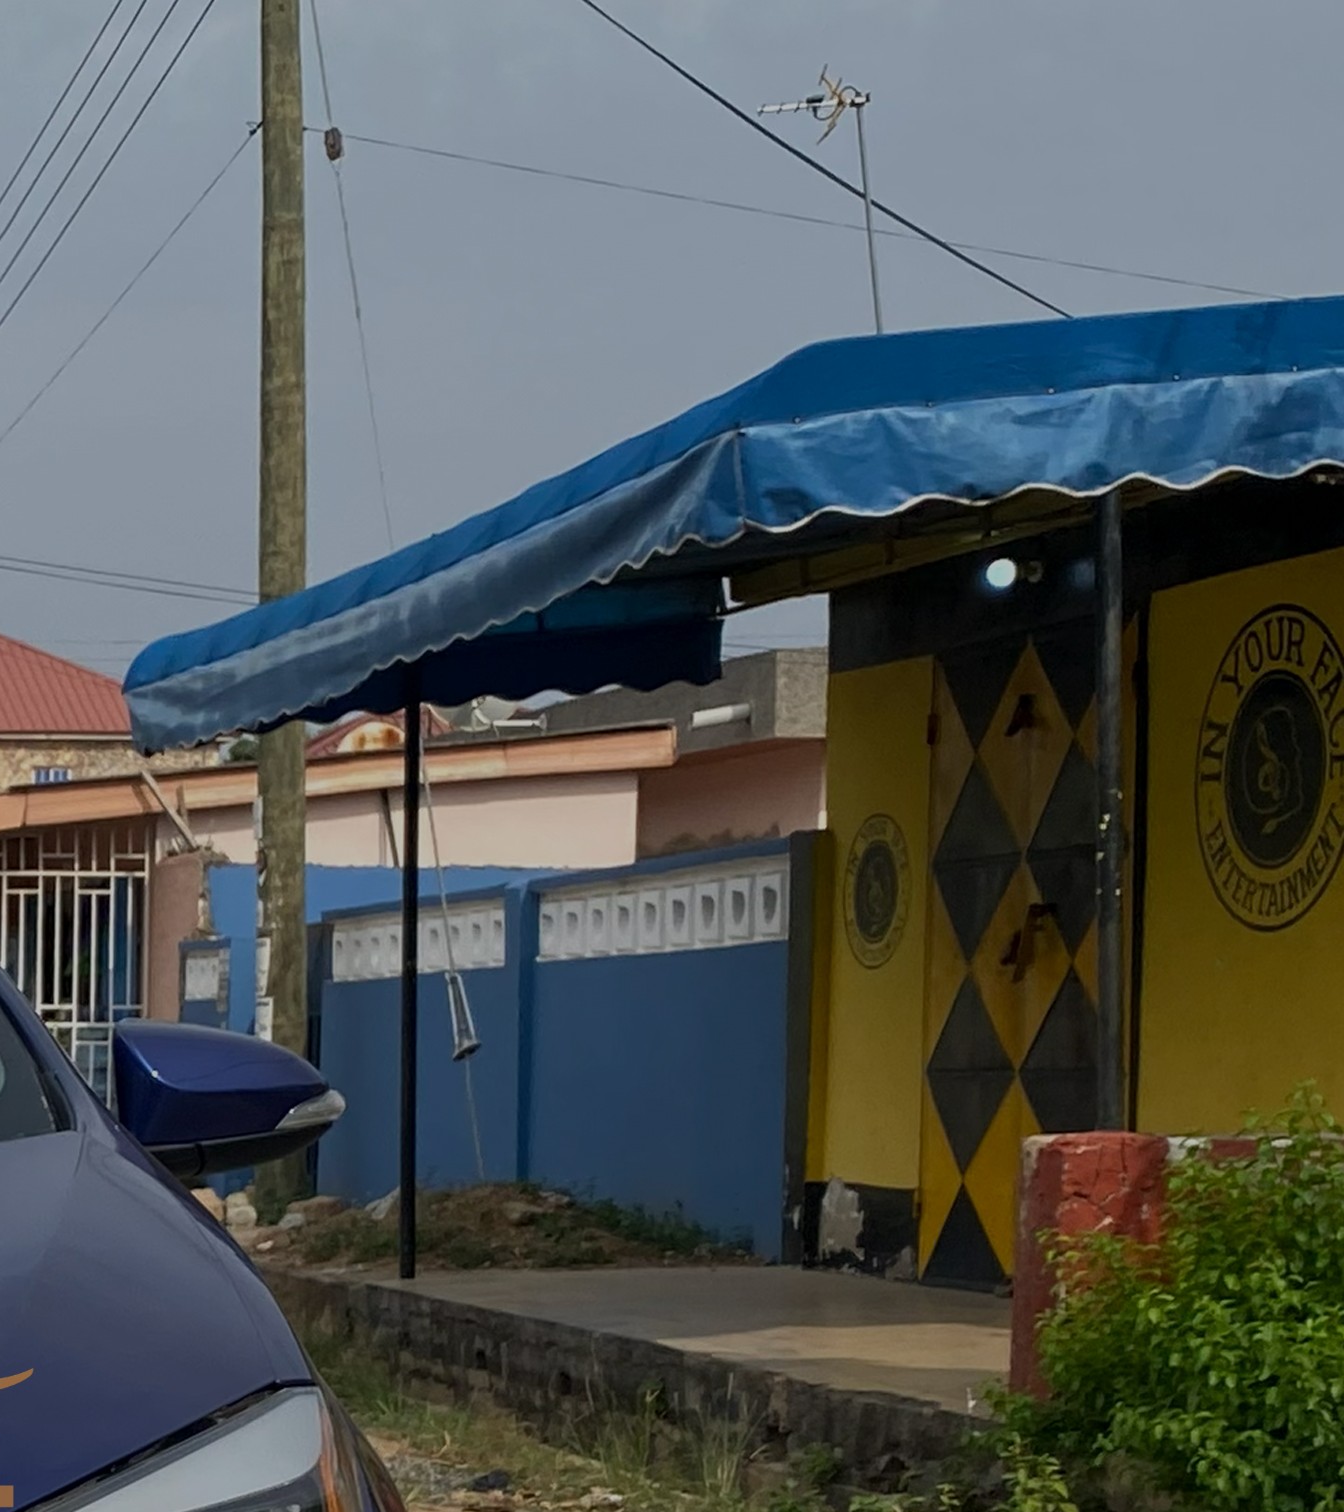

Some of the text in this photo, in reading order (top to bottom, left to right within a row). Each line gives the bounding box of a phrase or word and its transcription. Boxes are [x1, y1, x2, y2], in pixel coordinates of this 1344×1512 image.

[1200, 719, 1230, 785] IN
[1219, 616, 1306, 698] YOUR
[1204, 801, 1344, 918] ENTERTAINMENT
